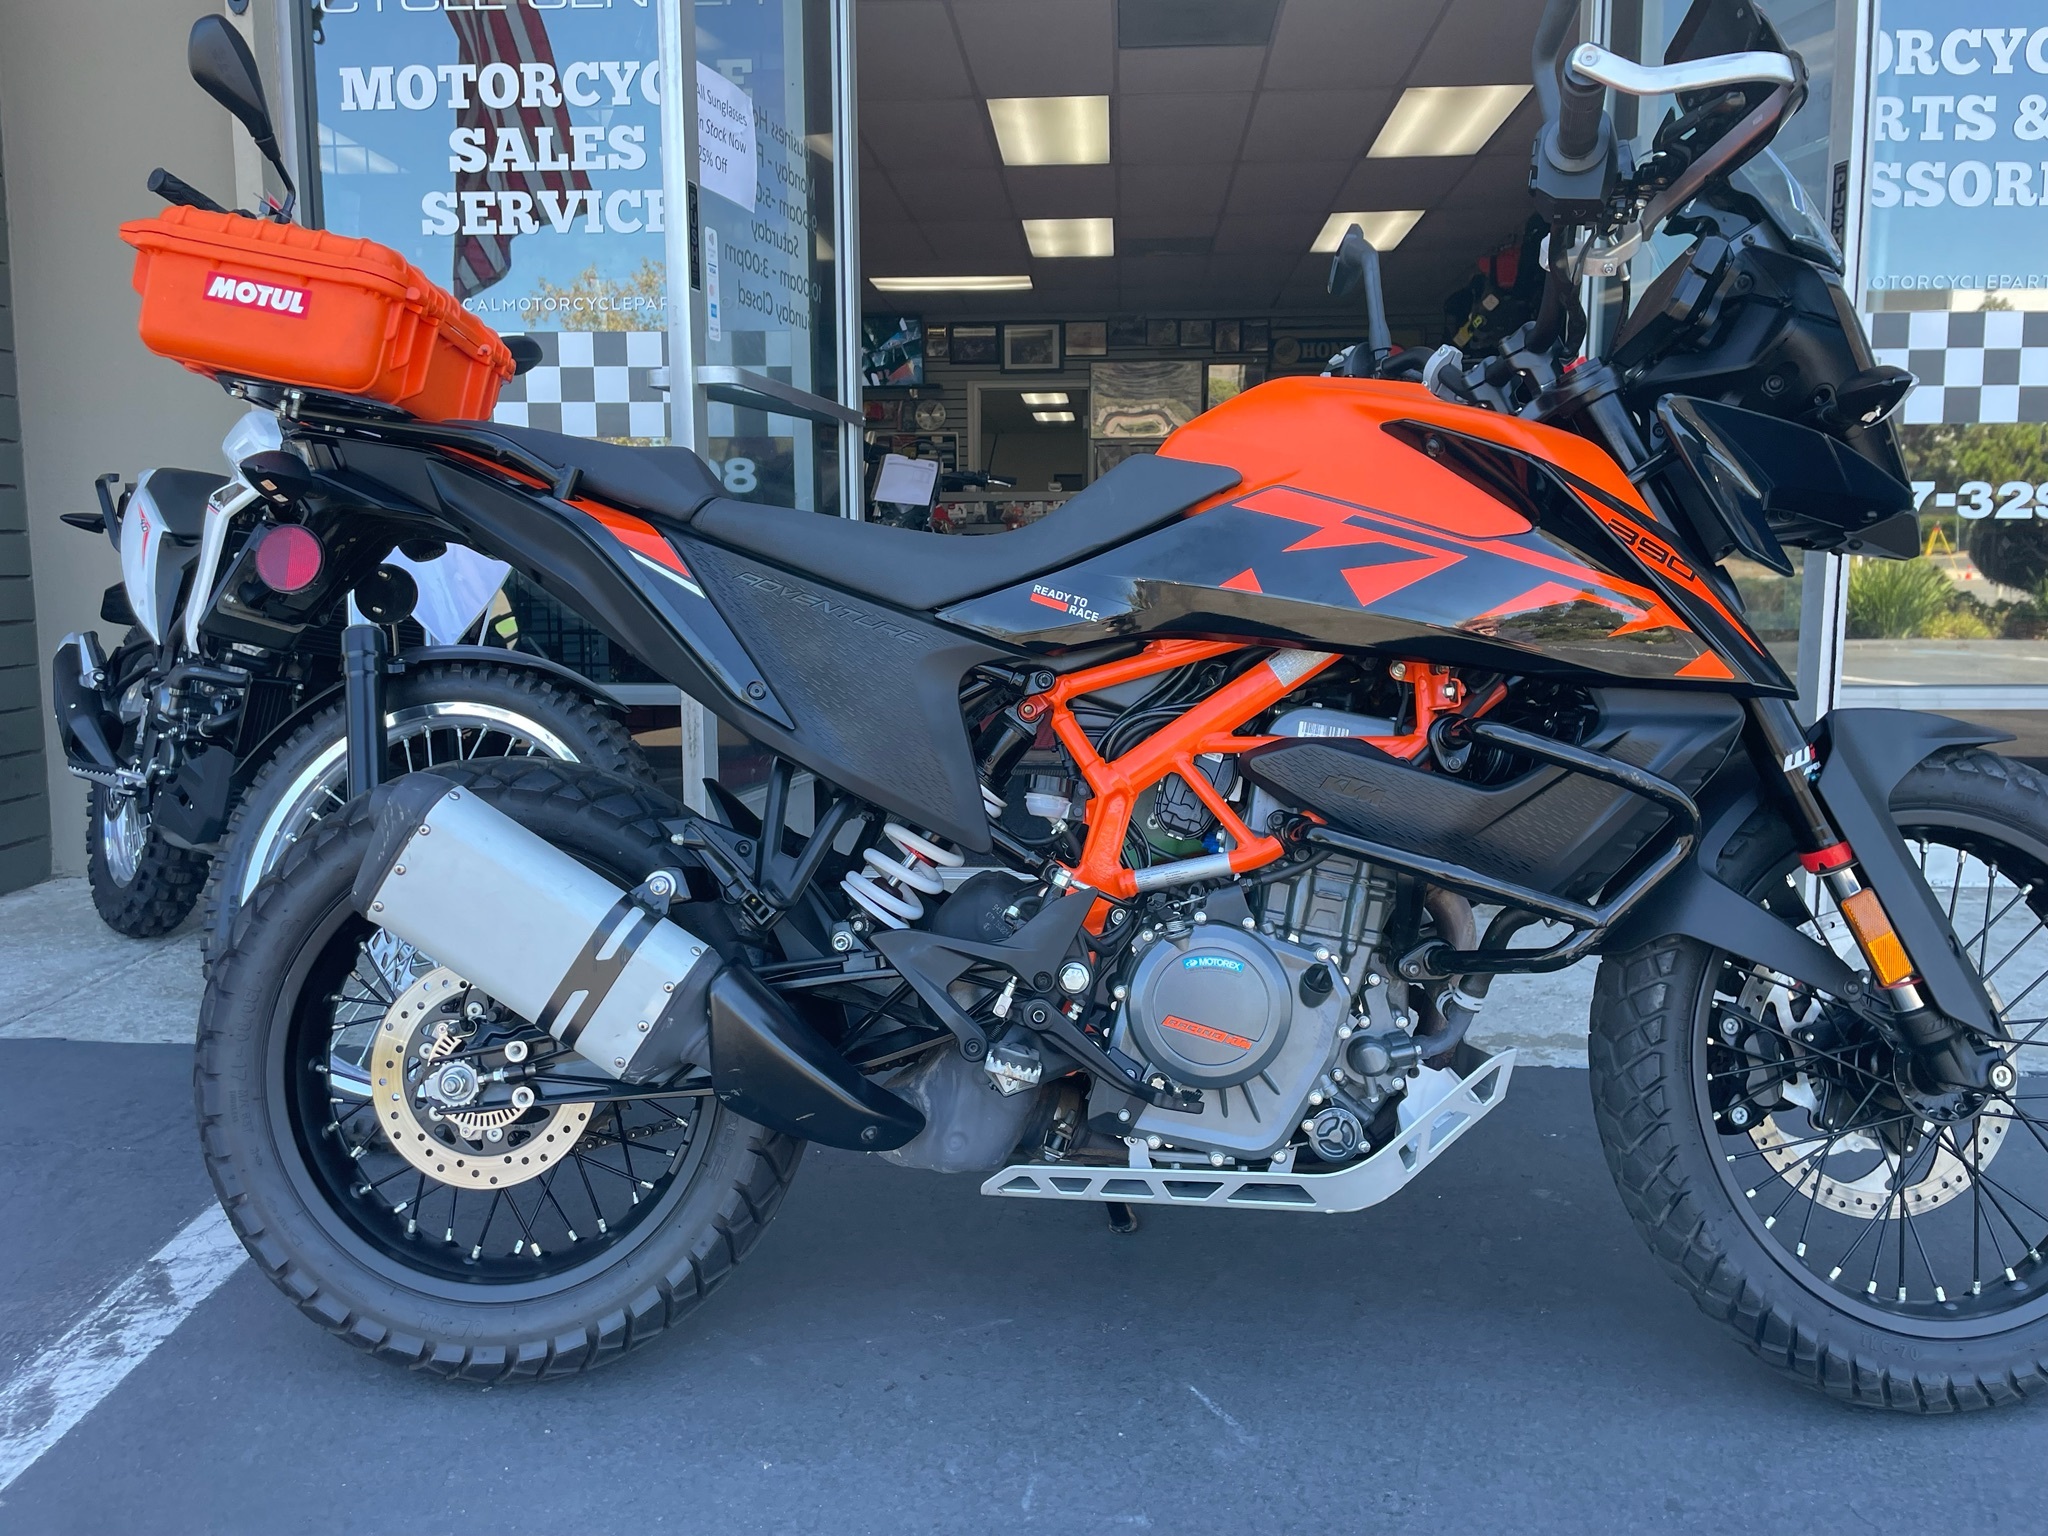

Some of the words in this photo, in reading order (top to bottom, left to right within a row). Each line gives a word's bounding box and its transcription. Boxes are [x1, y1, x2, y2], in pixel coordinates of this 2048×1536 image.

[706, 89, 748, 127] Sunglasses
[449, 125, 647, 173] SALES
[706, 119, 727, 144] Stock
[728, 132, 747, 155] Now
[715, 154, 728, 175] Off
[690, 191, 699, 264] PUSH
[207, 276, 304, 314] MOTUL
[1867, 274, 2048, 290] OTORCYCLEPART
[1608, 518, 1697, 582] 390
[732, 571, 928, 644] ADVENTURE
[1033, 584, 1072, 603] READY
[1073, 595, 1088, 608] TO
[1068, 604, 1100, 622] RACE
[1198, 957, 1242, 971] MOTOREX
